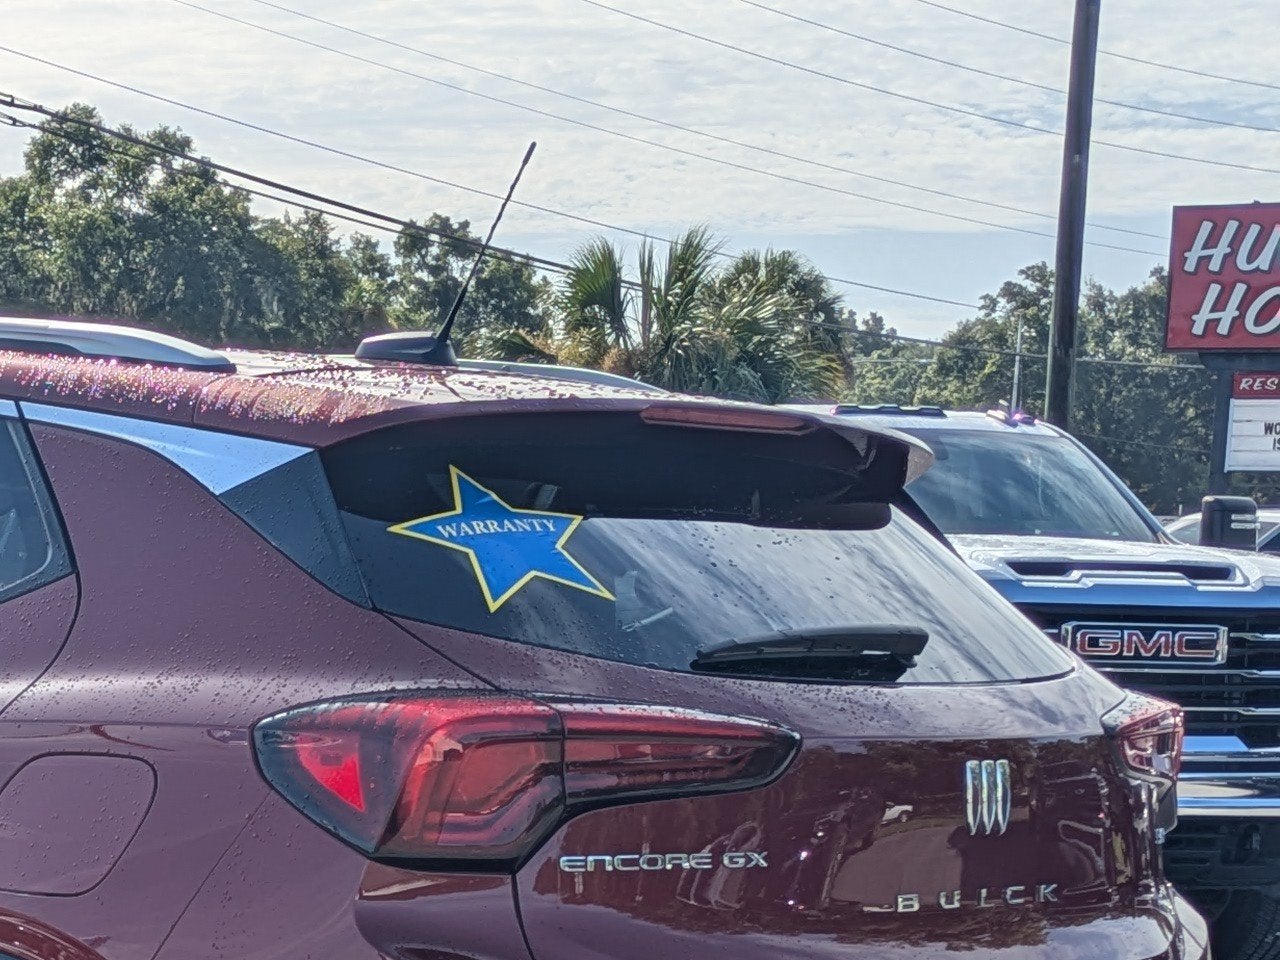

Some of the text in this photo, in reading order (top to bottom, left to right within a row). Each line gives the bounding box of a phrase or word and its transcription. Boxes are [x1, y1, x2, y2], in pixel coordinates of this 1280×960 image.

[1239, 377, 1279, 391] RES
[436, 518, 557, 539] WARRANTY
[1076, 629, 1218, 658] GMC
[559, 851, 769, 872] ENCORE GX
[897, 883, 1058, 913] BUICK
